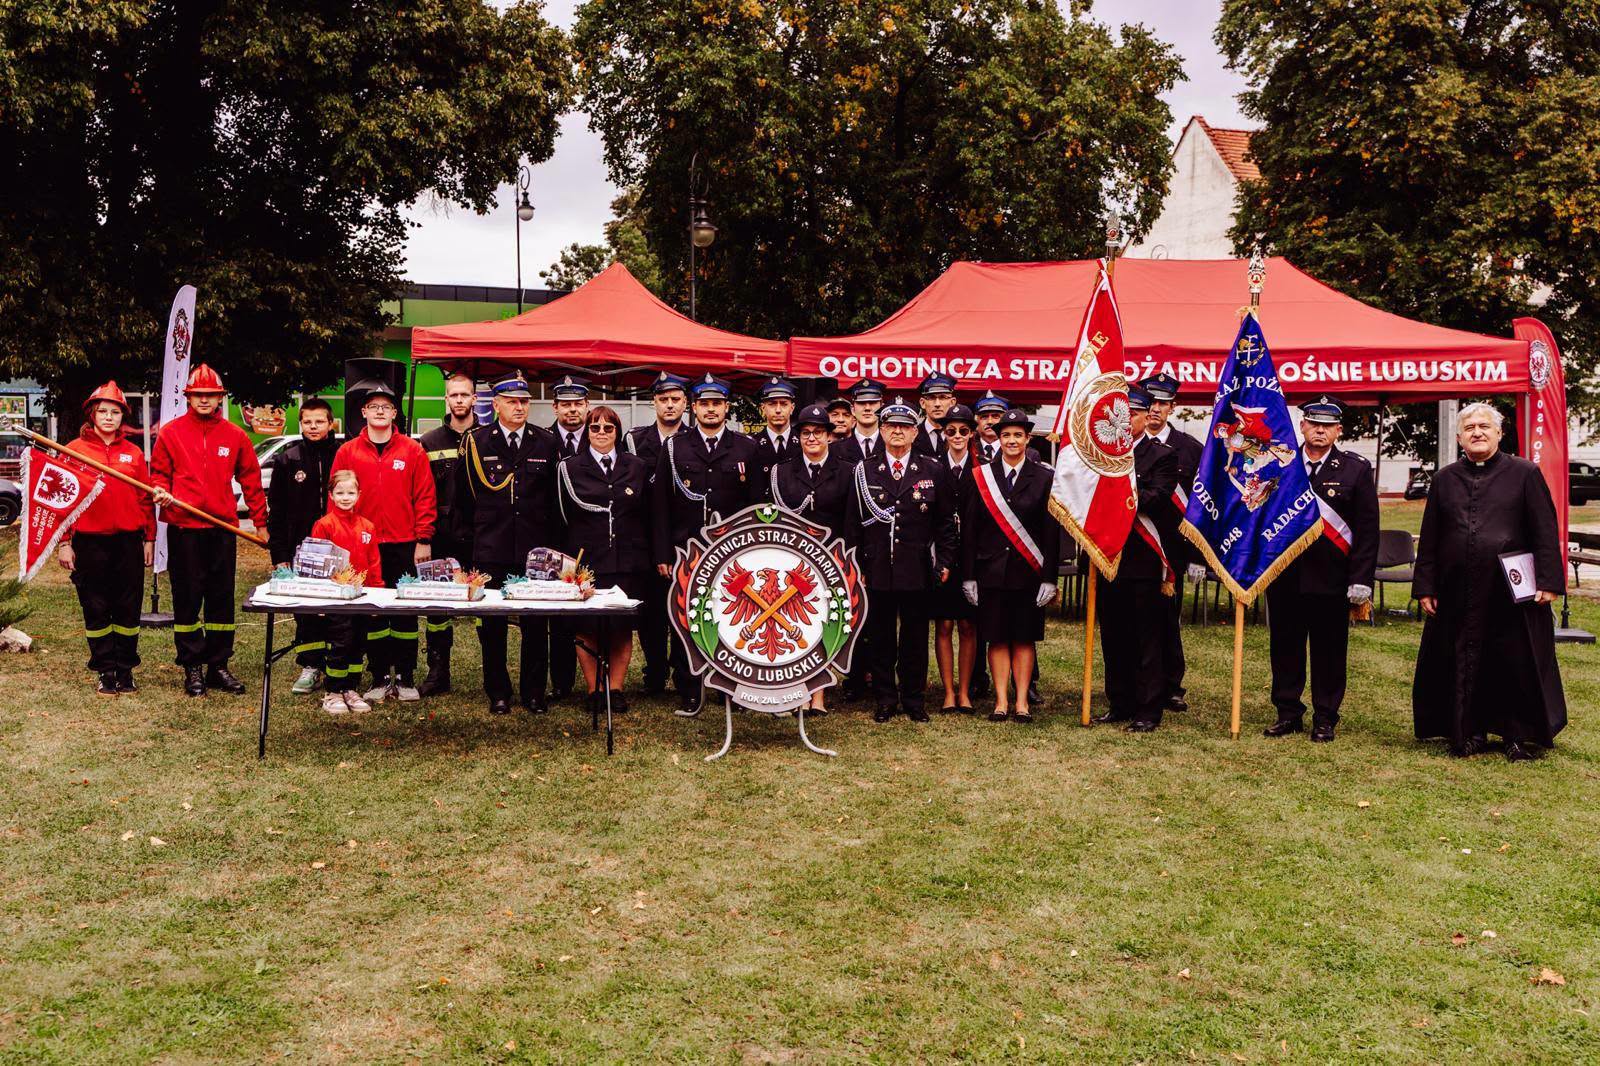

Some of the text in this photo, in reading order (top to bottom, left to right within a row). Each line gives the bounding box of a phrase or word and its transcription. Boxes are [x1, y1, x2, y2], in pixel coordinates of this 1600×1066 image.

[819, 355, 1508, 382] OCHOTNICZA STRA OŻARN OŚNIE LUBUSKIM
[1215, 376, 1285, 404] RAŻ POŻA
[1192, 474, 1219, 521] OCHO
[1261, 489, 1316, 543] RADACH
[1219, 526, 1243, 555] 1948
[696, 530, 840, 586] OCHOTNICZA STRAŻ POŻARNA
[717, 649, 823, 682] OŚNO LUBUSKIE
[741, 691, 759, 704] ROK
